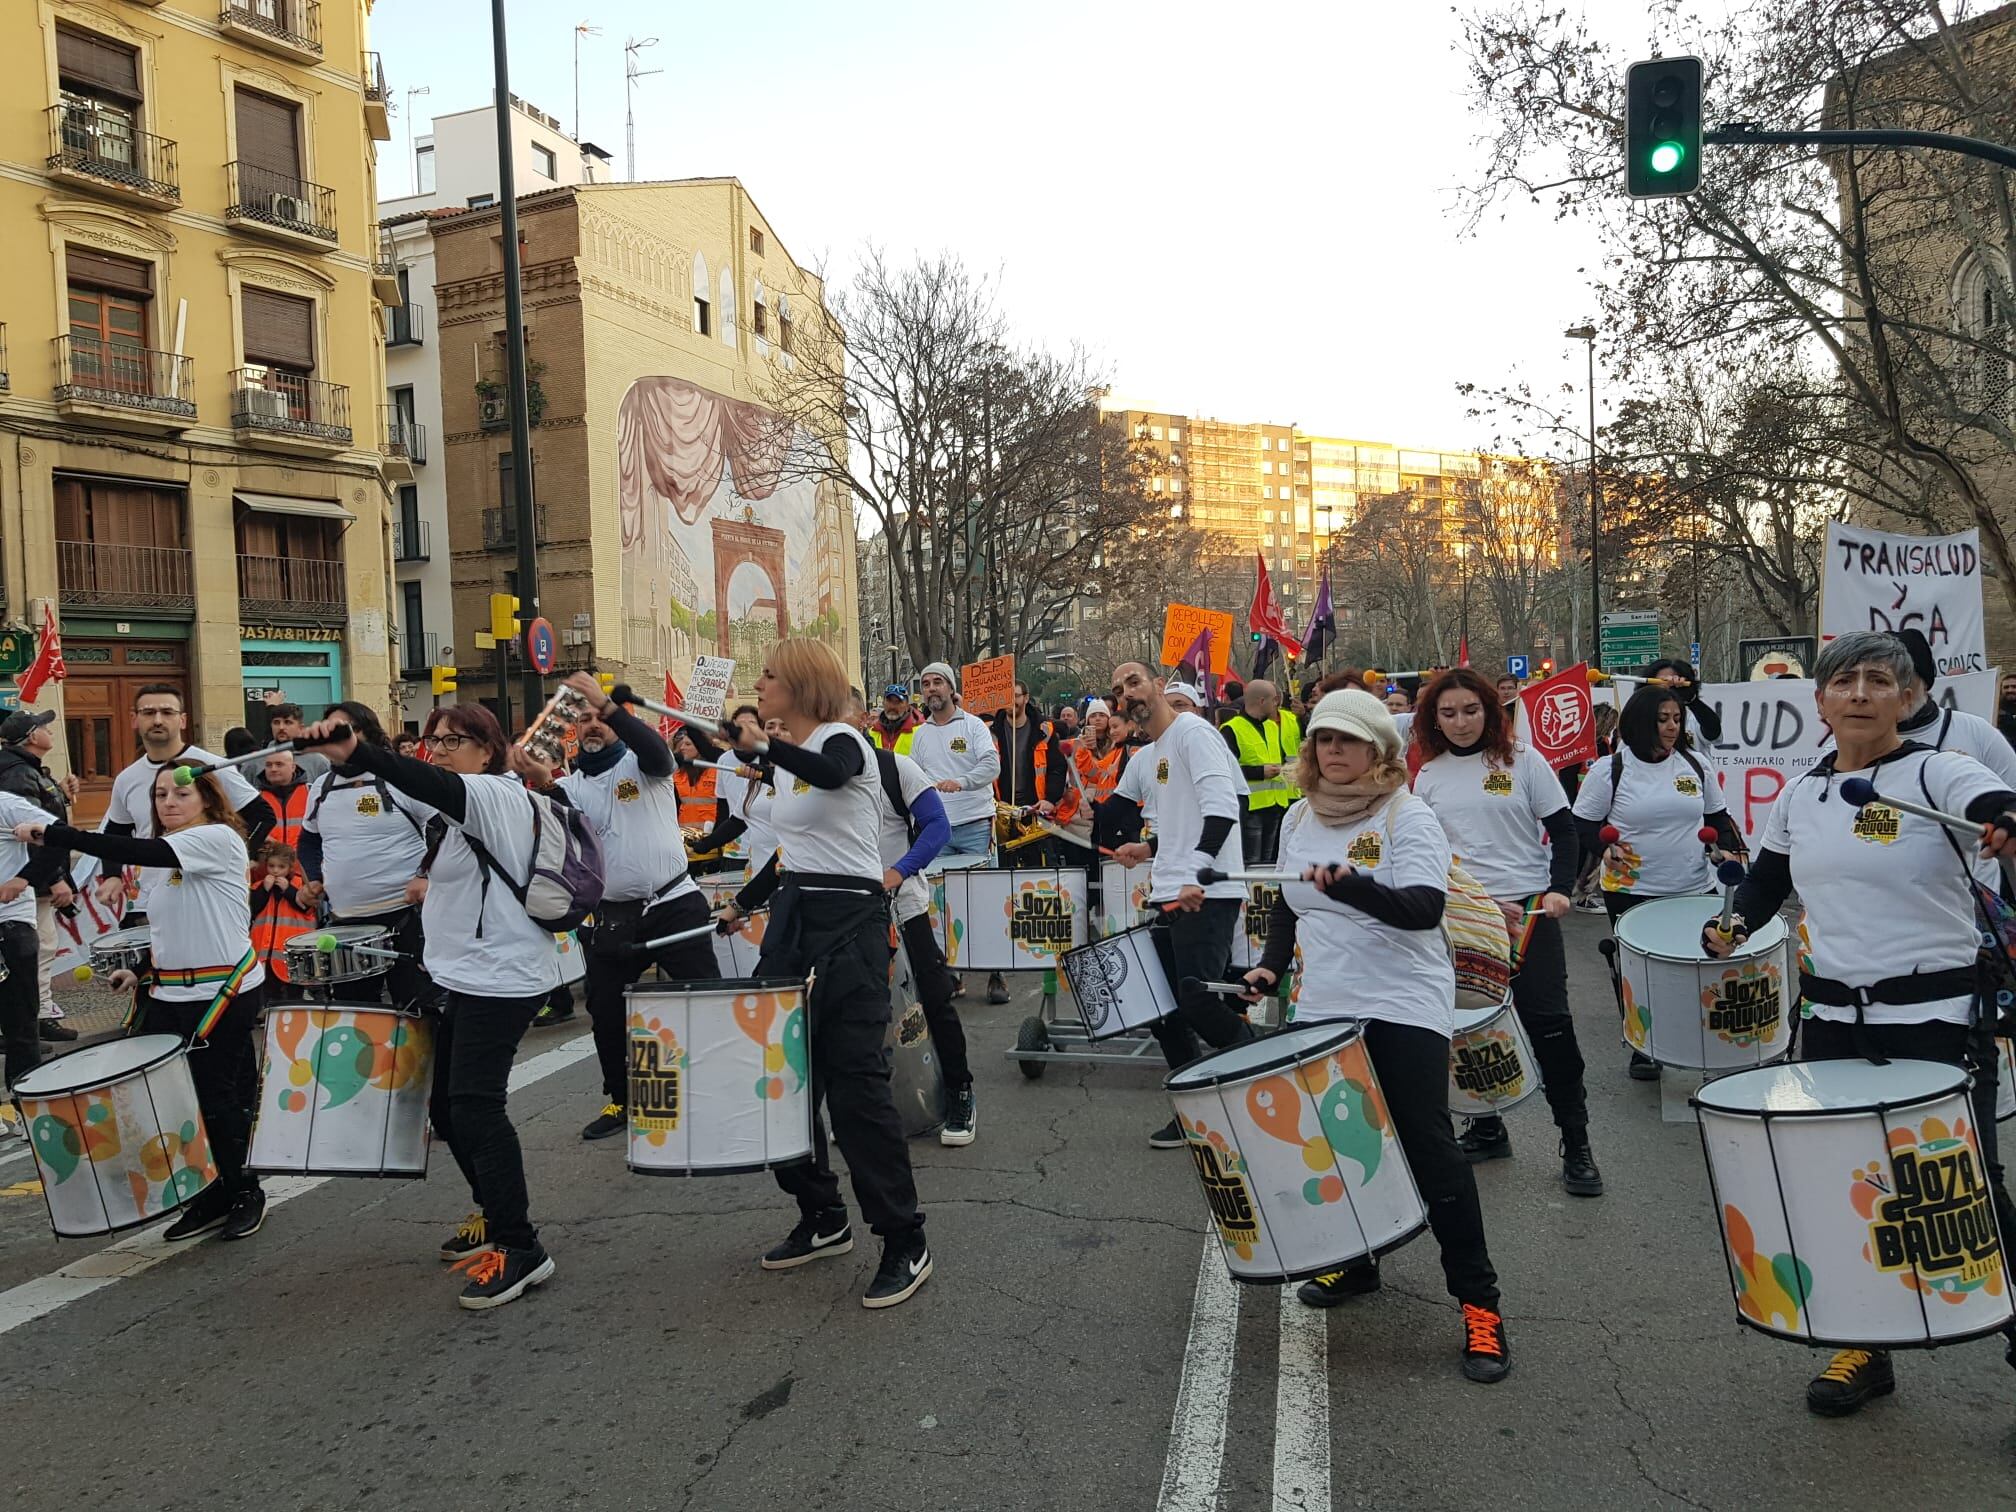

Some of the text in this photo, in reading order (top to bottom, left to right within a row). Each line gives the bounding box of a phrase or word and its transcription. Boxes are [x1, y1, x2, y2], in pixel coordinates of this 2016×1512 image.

[1838, 538, 1976, 576] TRANSALUD
[1172, 621, 1185, 632] NO
[1187, 623, 1198, 634] SE
[1173, 608, 1225, 629] REPOLLES
[1168, 635, 1186, 648] CON
[971, 659, 1004, 678] DEP
[1511, 658, 1523, 676] P
[964, 671, 1012, 688] AMBULANCIAS
[964, 688, 982, 699] ESTE
[693, 703, 720, 718] HUESOS
[1553, 691, 1581, 738] UGT
[1714, 700, 1803, 750] LUD
[1733, 756, 1785, 767] SANITARIO
[1853, 821, 1898, 835] BATUQUE
[1010, 918, 1072, 943] BATUQUE
[1709, 998, 1780, 1033] BATUQUE
[1874, 1201, 1998, 1272] BATUQU
